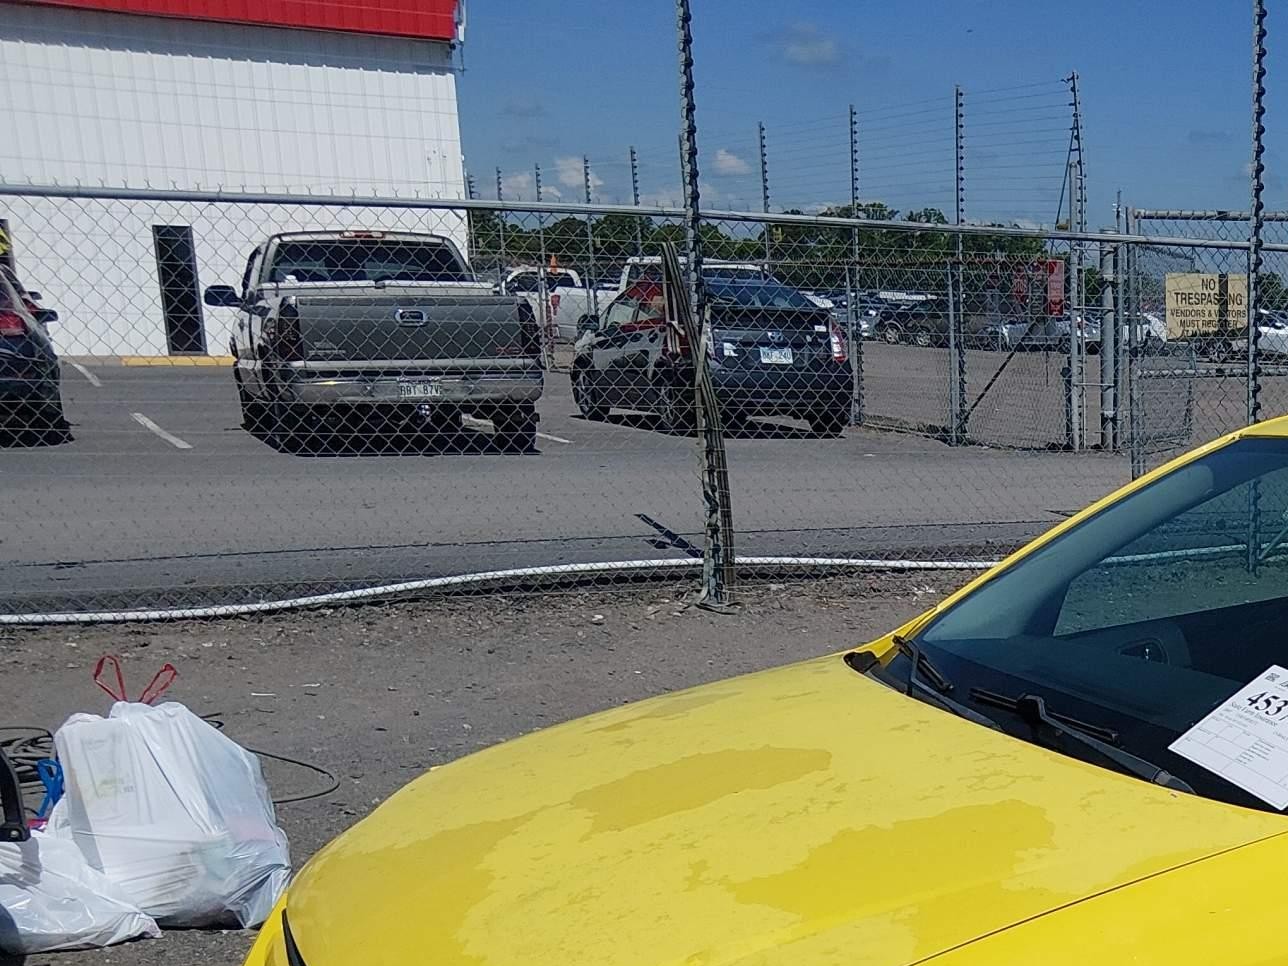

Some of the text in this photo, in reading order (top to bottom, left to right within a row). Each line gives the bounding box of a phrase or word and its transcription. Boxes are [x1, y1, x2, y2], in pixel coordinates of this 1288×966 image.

[1201, 278, 1216, 291] NO
[1174, 292, 1243, 306] TRESPASNG
[1170, 308, 1247, 318] VENDORS & VTORS
[1179, 319, 1238, 329] MUST REGTER
